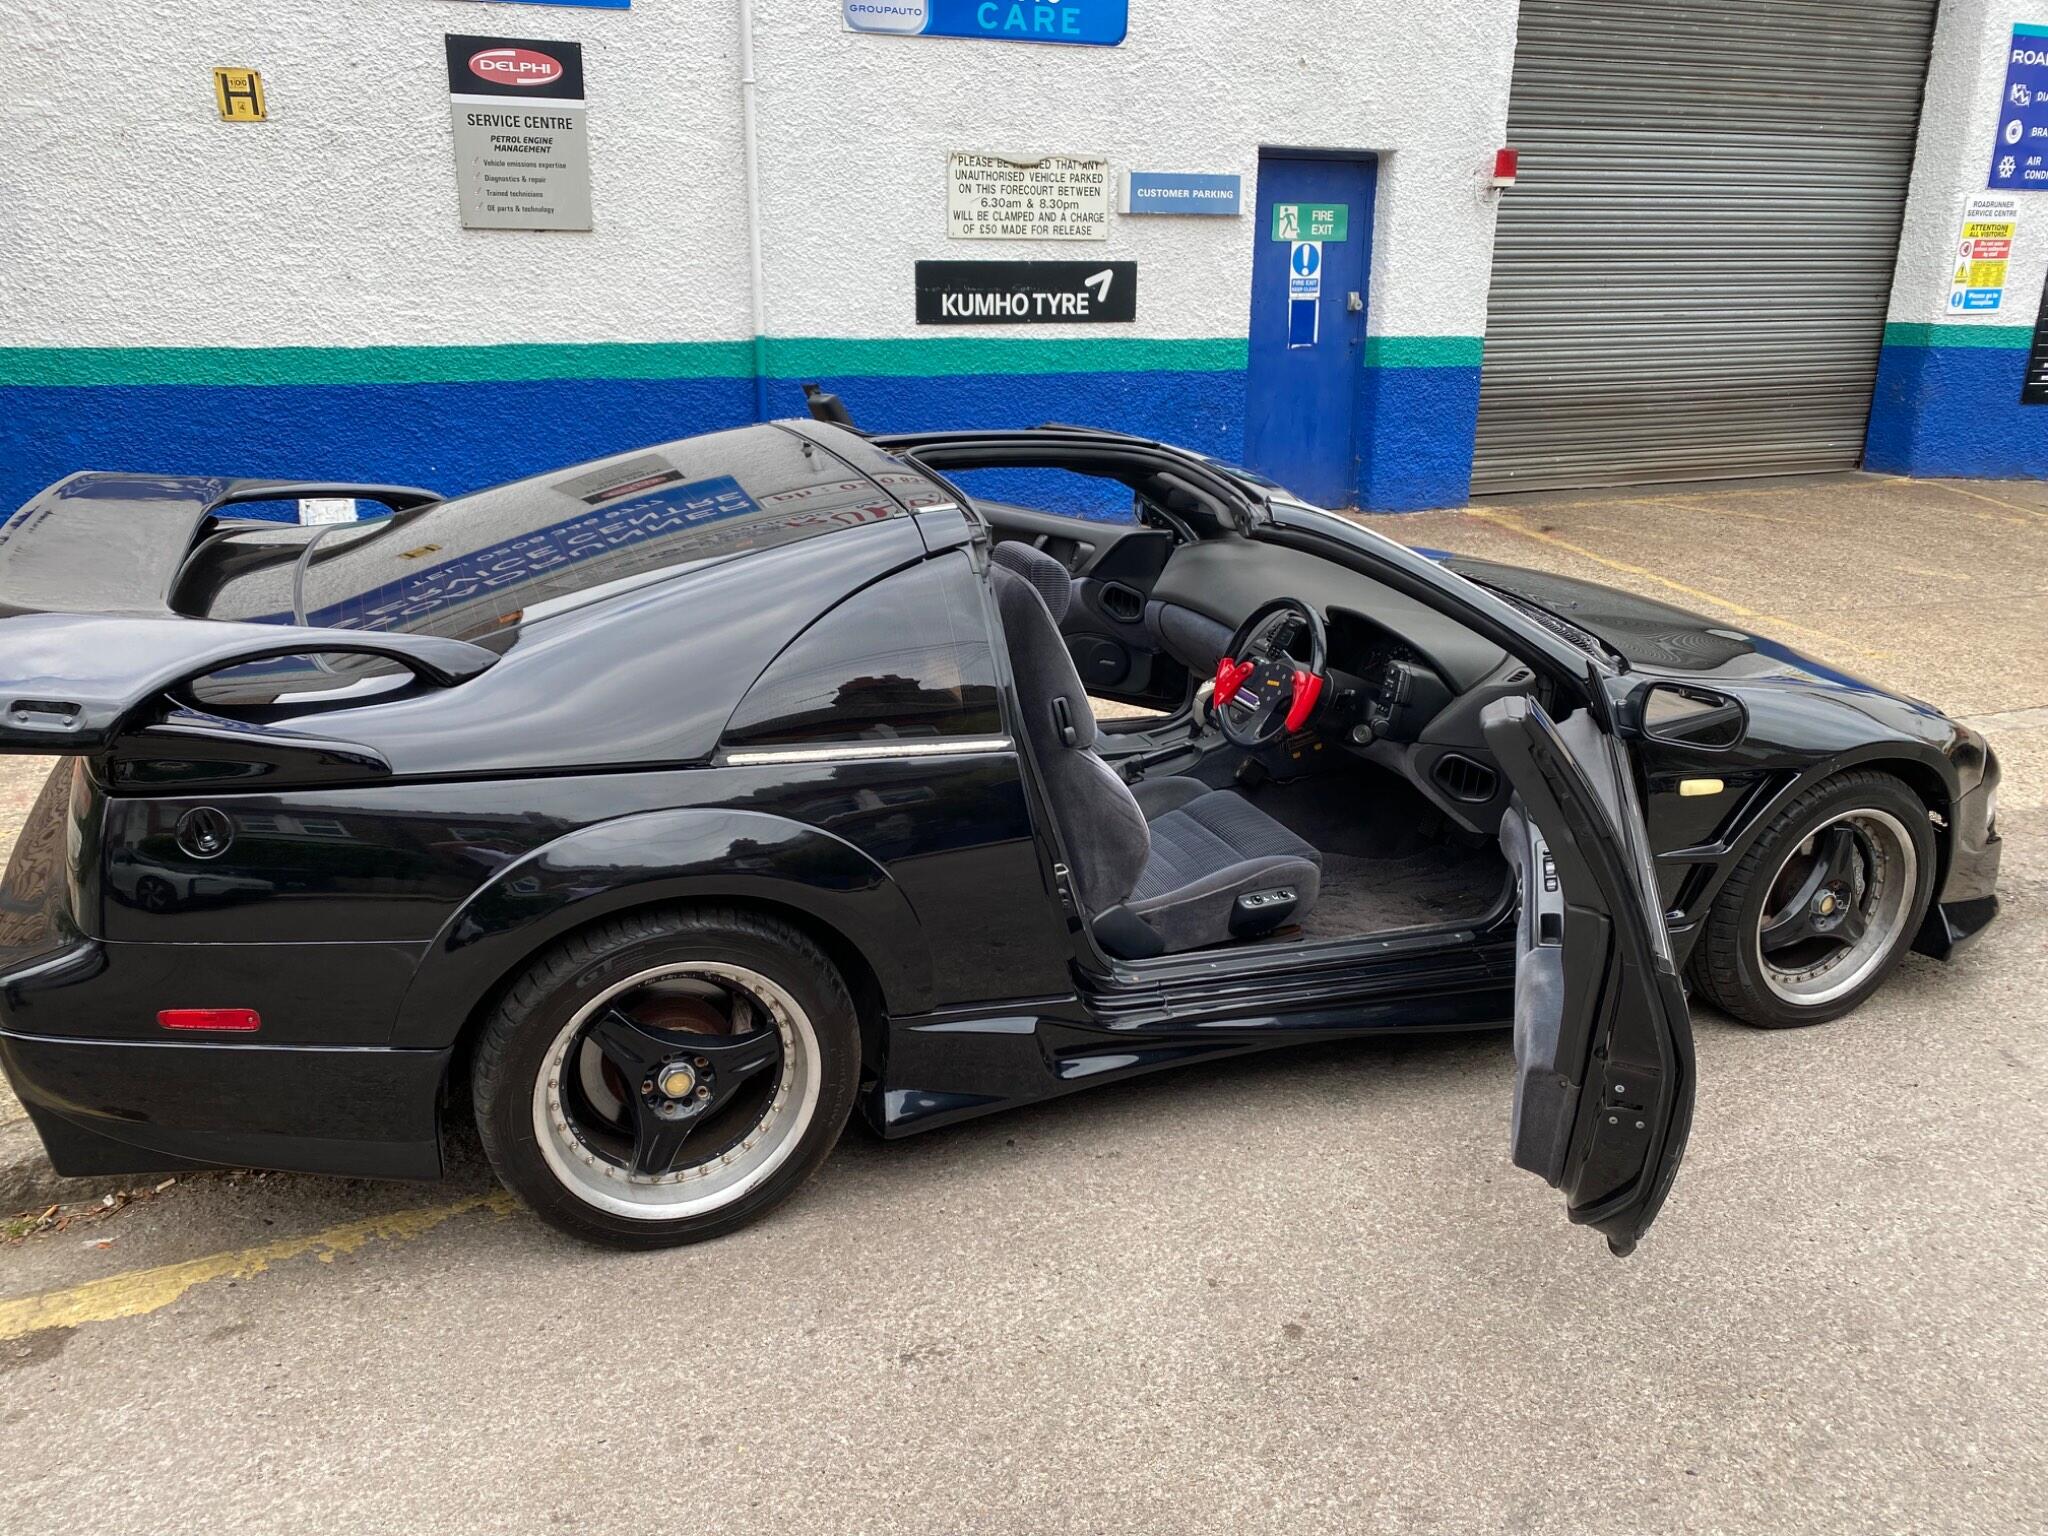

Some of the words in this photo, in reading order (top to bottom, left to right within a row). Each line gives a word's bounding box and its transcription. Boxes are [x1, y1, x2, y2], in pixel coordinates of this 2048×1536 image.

[850, 4, 922, 16] GROUPAUTO
[977, 2, 1080, 34] CARE
[2012, 49, 2048, 65] ROA
[479, 59, 551, 75] DELPHI
[220, 73, 260, 116] H
[467, 114, 521, 128] SERVICE
[524, 115, 573, 130] CENTRE
[490, 135, 521, 144] PETROL
[523, 136, 553, 145] ENGINE
[494, 144, 552, 154] MANAGEMENT
[538, 162, 566, 170] expertise
[958, 156, 993, 168] PLEASE
[997, 158, 1009, 168] BE
[1055, 160, 1076, 170] THAT
[1081, 160, 1100, 170] ANY
[2026, 156, 2042, 166] AIR
[484, 174, 520, 183] Diagnostics
[528, 176, 546, 184] repair
[955, 170, 1024, 182] UNAUTHORISED
[1029, 172, 1066, 183] VEHICLE
[1069, 173, 1104, 184] PARKED
[510, 190, 544, 198] technicians
[958, 184, 972, 194] ON
[976, 184, 996, 194] THIS
[1000, 184, 1054, 196] FORECOURT
[1058, 186, 1100, 196] BETWEEN
[1137, 188, 1190, 198] CUSTOMER
[1192, 190, 1234, 199] PARKING
[497, 205, 514, 213] parts
[521, 206, 554, 214] technology
[980, 198, 1022, 208] 6.30am
[1026, 199, 1034, 208] &
[1039, 199, 1080, 211] 8.30pm
[1972, 200, 2015, 208] ROADRUNNER
[953, 210, 974, 221] WILL
[977, 210, 989, 221] BE
[992, 212, 1034, 222] CLAMPED
[1038, 212, 1056, 222] AND
[1060, 212, 1067, 222] A
[1070, 212, 1104, 223] CHARGE
[1312, 210, 1334, 222] FIRE
[962, 224, 975, 234] OF
[979, 224, 997, 234] £50
[1002, 224, 1027, 235] MADE
[1031, 225, 1049, 235] FOR
[1052, 225, 1092, 236] RELEASE
[1311, 224, 1334, 235] EXIT
[942, 292, 1028, 316] KUMHO
[1032, 293, 1090, 316] TYRE
